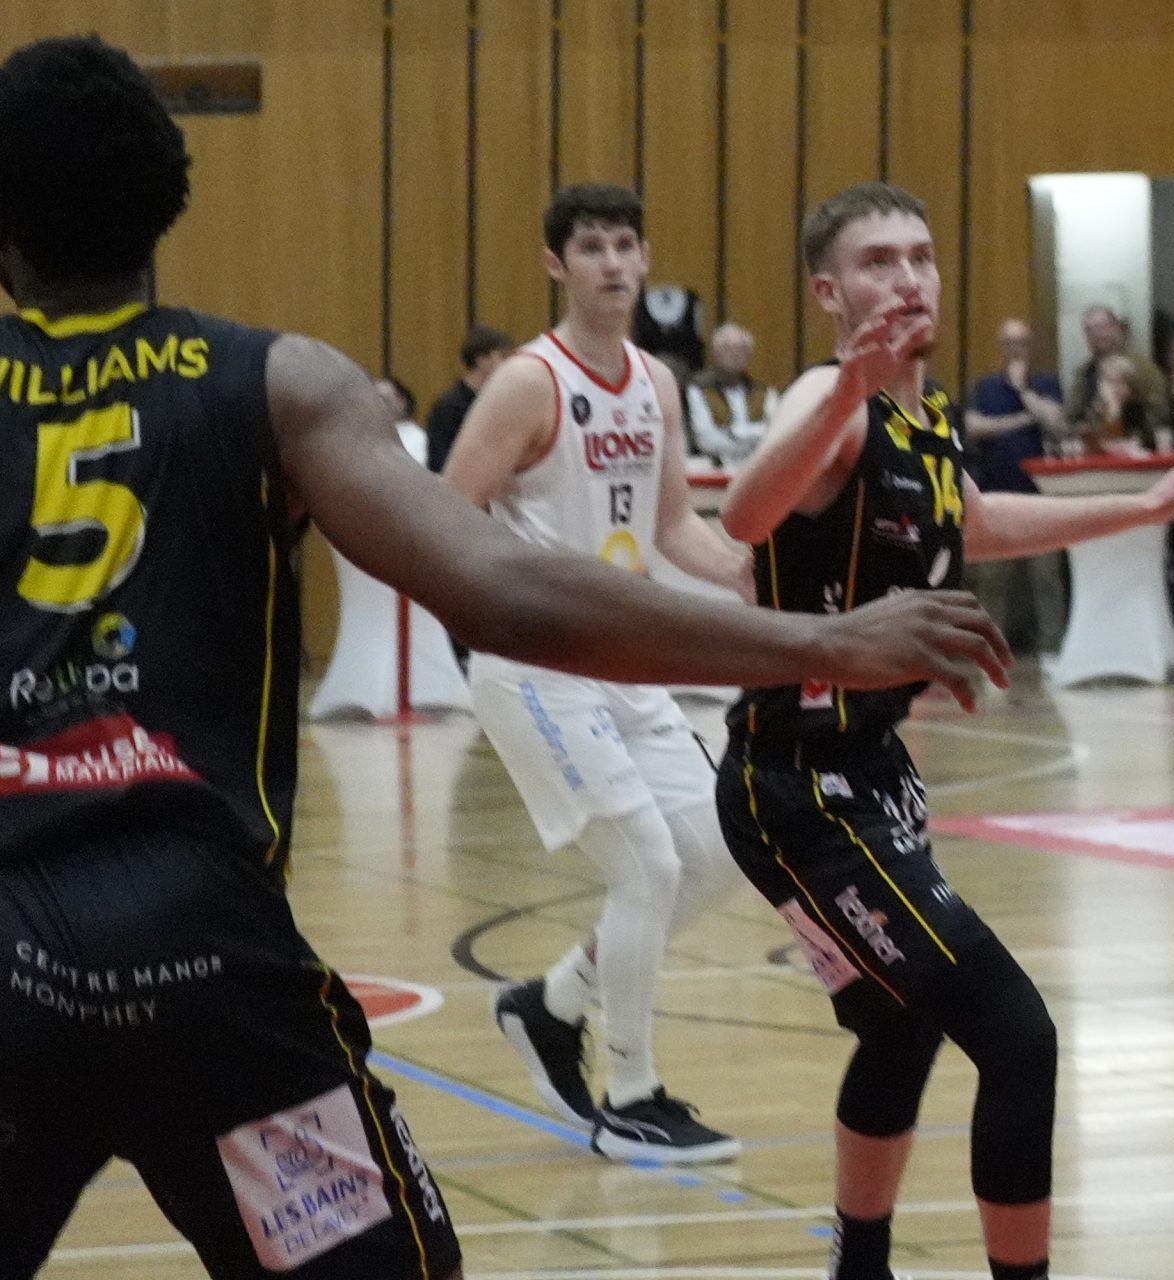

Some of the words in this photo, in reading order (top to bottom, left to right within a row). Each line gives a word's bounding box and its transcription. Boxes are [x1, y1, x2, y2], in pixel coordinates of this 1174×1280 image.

[584, 429, 654, 472] LIONS
[17, 402, 147, 613] 5
[921, 453, 963, 527] 14
